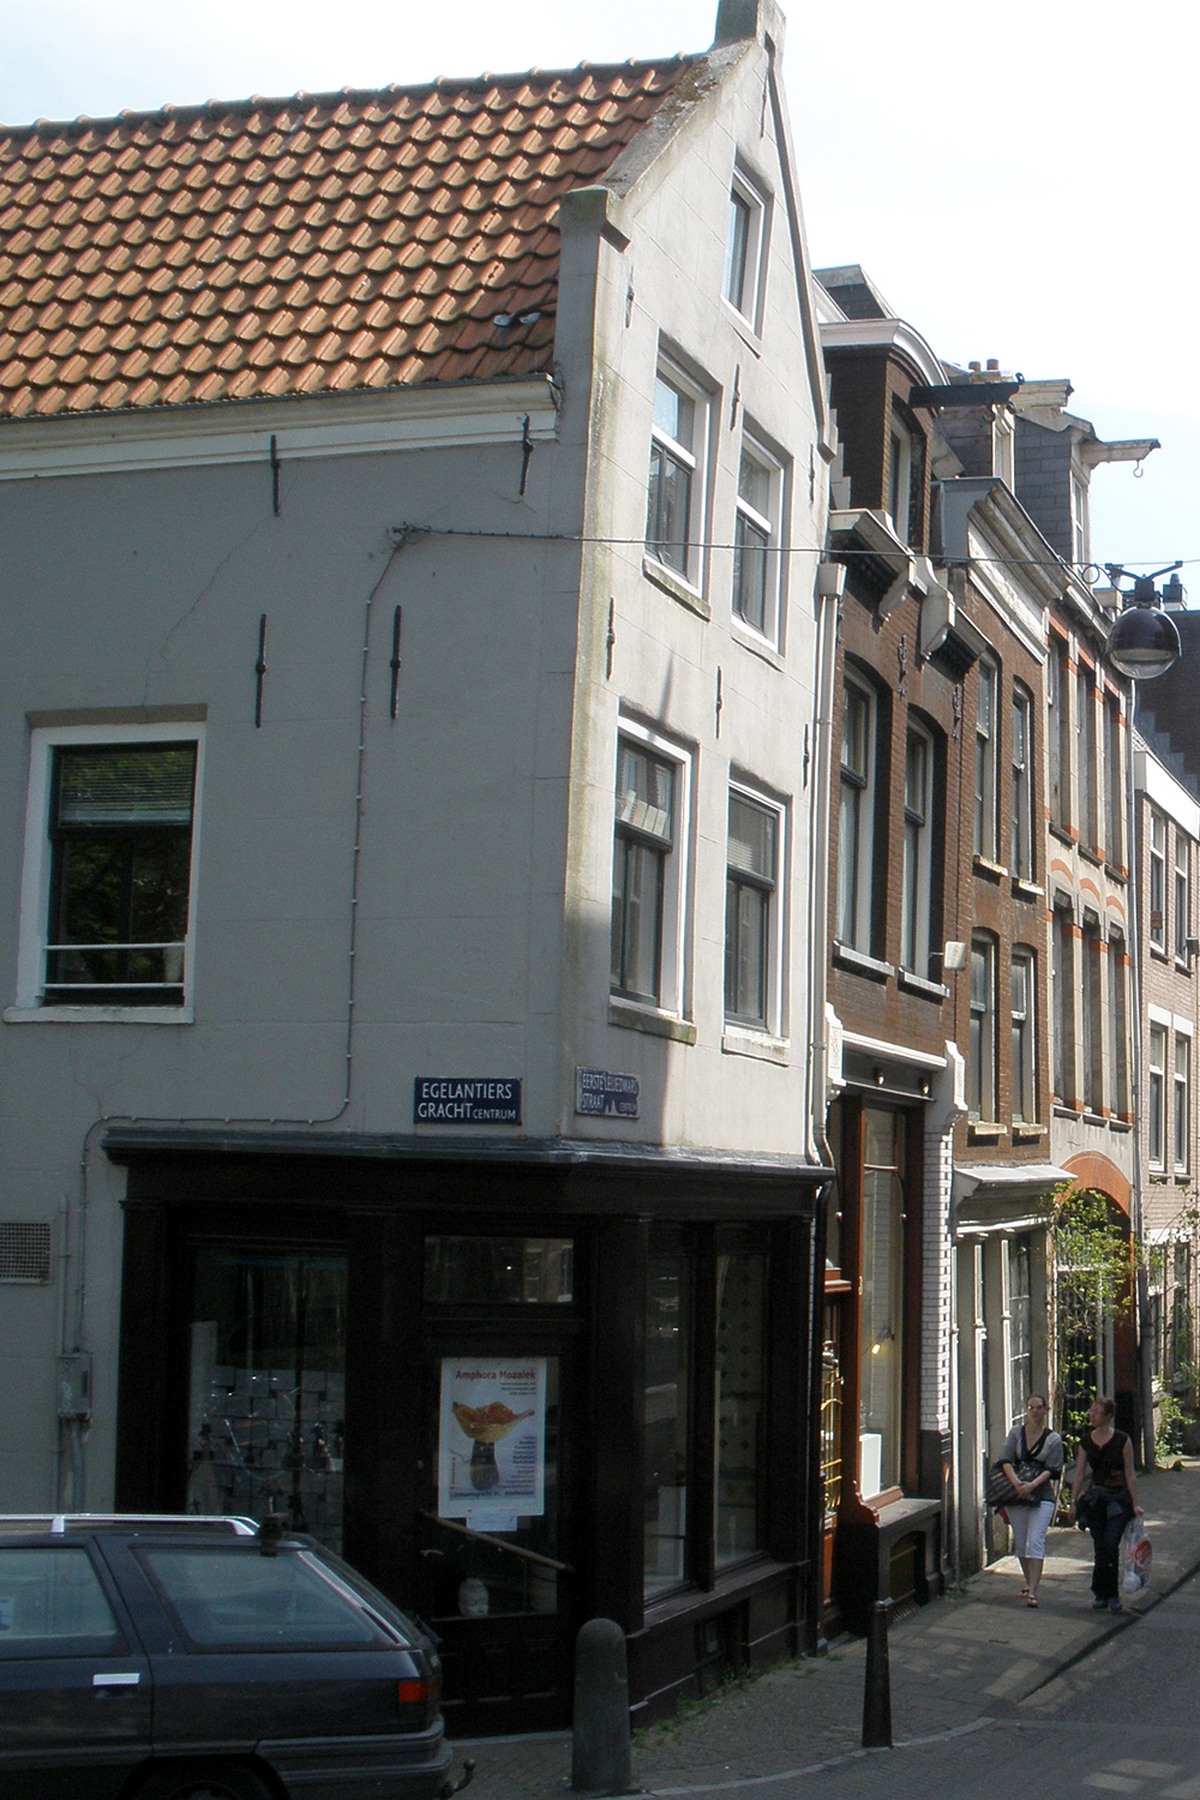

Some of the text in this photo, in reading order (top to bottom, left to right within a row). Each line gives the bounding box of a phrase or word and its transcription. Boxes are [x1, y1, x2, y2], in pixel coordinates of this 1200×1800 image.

[422, 1082, 512, 1099] EGELANTIERS
[582, 1073, 603, 1091] EERSTE
[582, 1092, 605, 1109] STRAAT
[417, 1102, 516, 1120] GRACHT CENTRUM
[455, 1370, 496, 1382] Amphora
